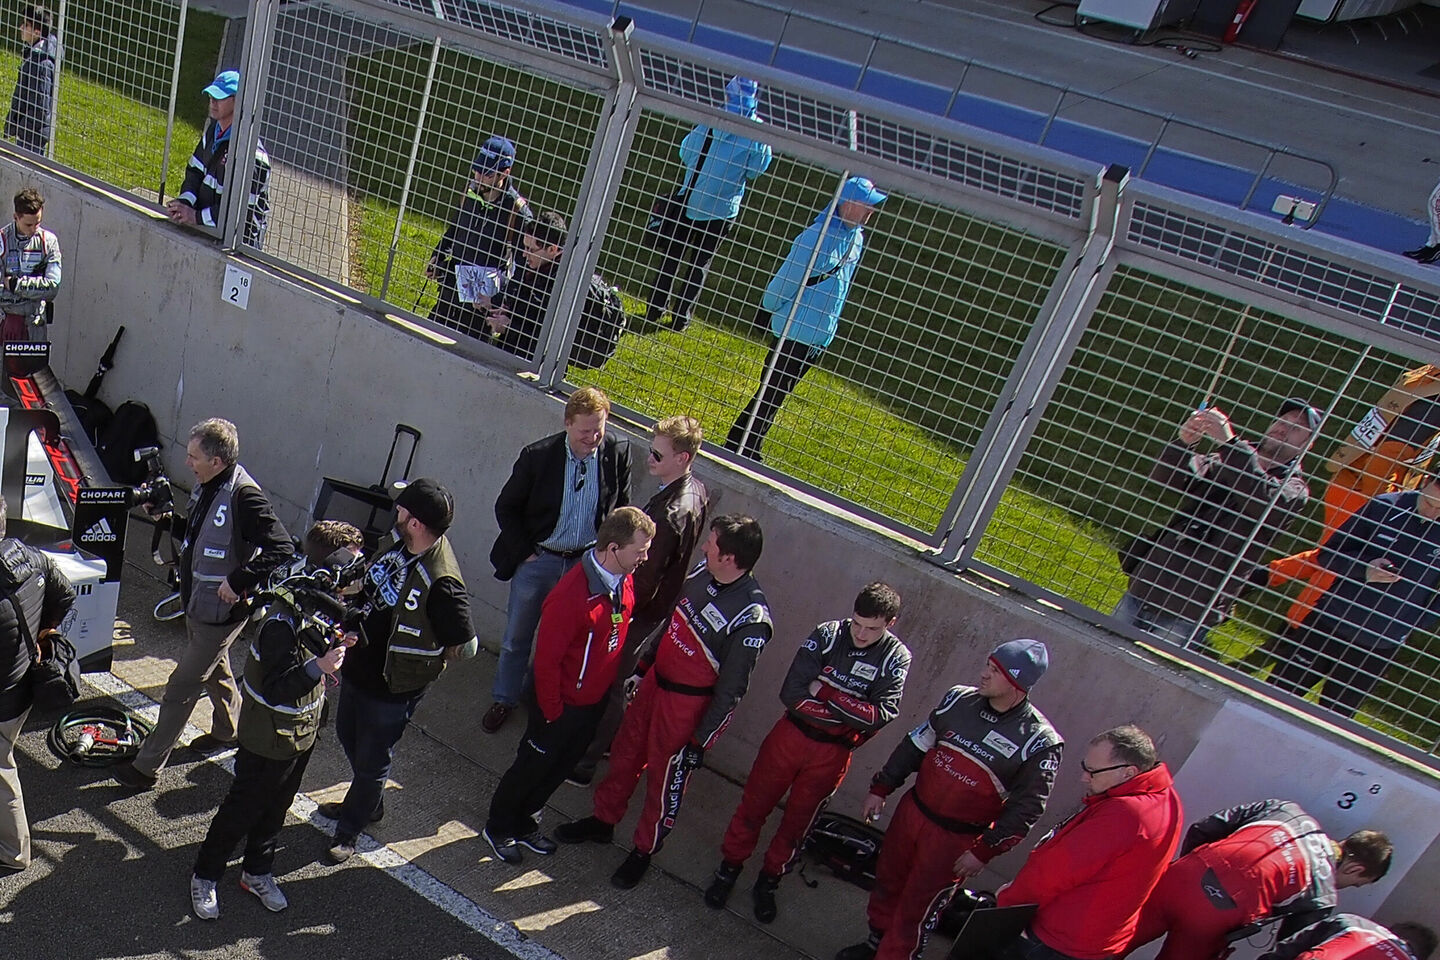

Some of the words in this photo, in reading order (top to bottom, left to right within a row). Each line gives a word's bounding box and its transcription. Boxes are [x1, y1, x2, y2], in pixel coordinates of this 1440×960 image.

[240, 277, 249, 287] 18
[230, 287, 239, 302] 2
[5, 345, 47, 353] CHOPARD
[213, 505, 228, 527] 5
[81, 533, 117, 542] adidas
[405, 588, 421, 611] 5
[953, 733, 972, 749] Audi
[971, 743, 995, 762] Sport
[943, 764, 979, 787] Service
[1369, 784, 1382, 795] 8
[1337, 792, 1358, 810] 3
